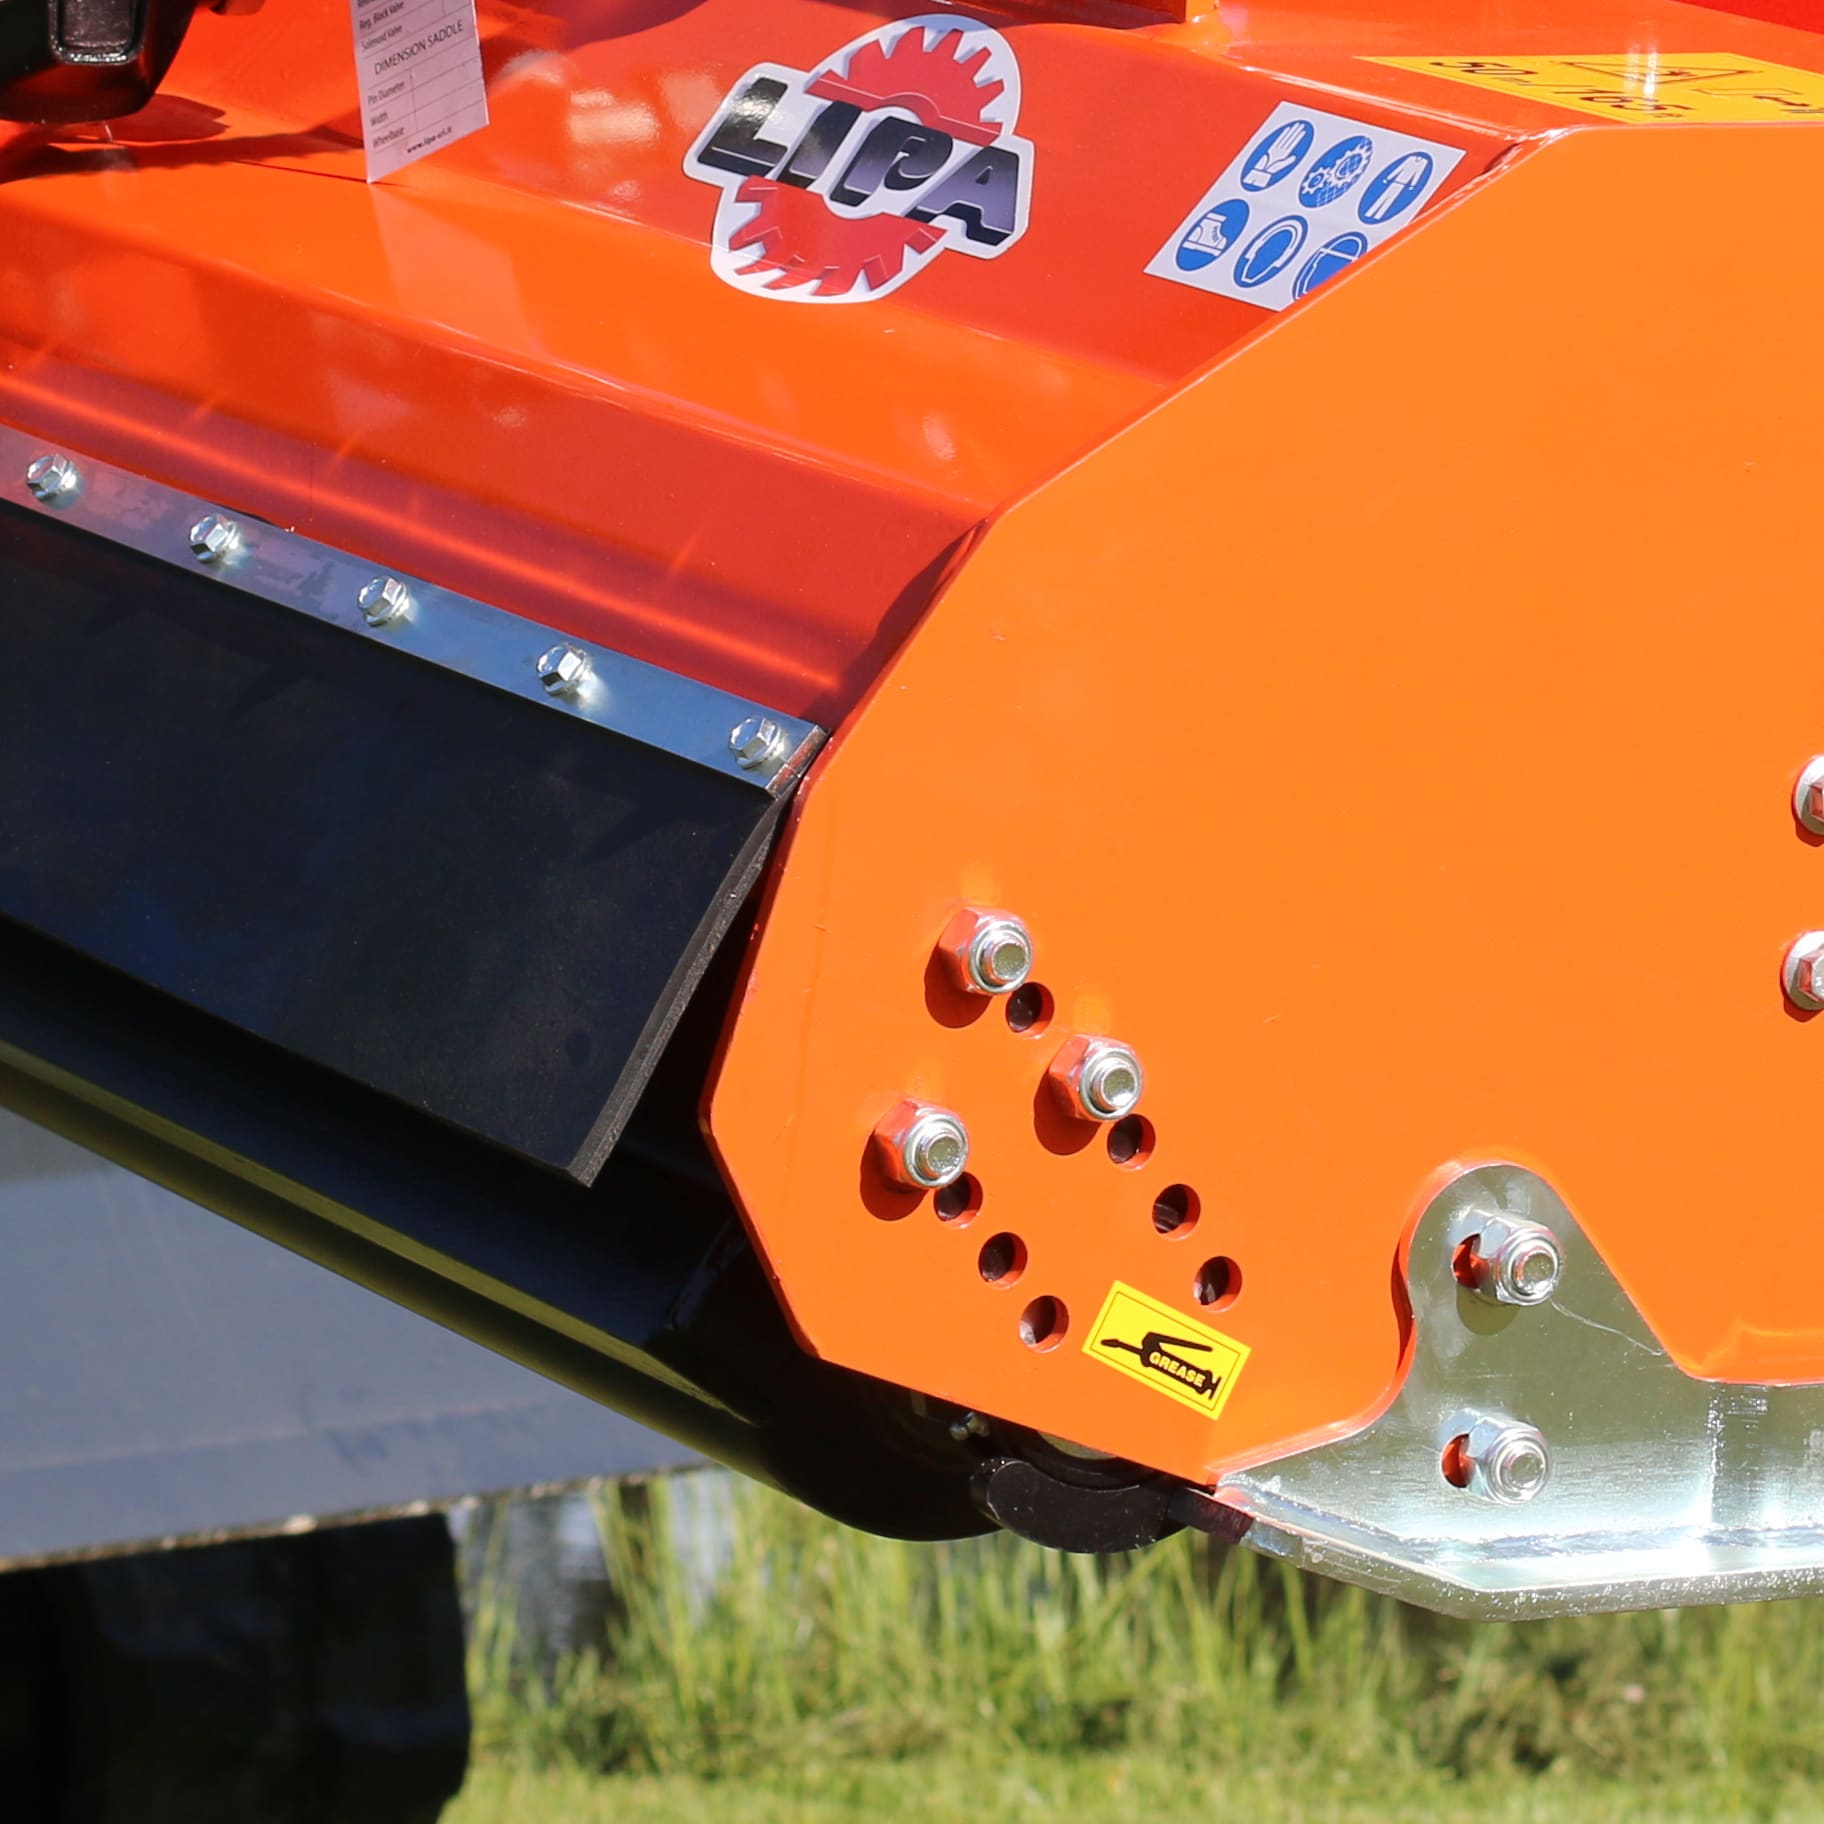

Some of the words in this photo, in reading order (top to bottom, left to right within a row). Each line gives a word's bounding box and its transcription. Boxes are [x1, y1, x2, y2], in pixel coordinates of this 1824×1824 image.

[374, 40, 426, 75] DIMENSION
[427, 19, 464, 49] SADDLE
[696, 75, 1020, 247] LIPA
[1148, 1351, 1206, 1388] GREASE
